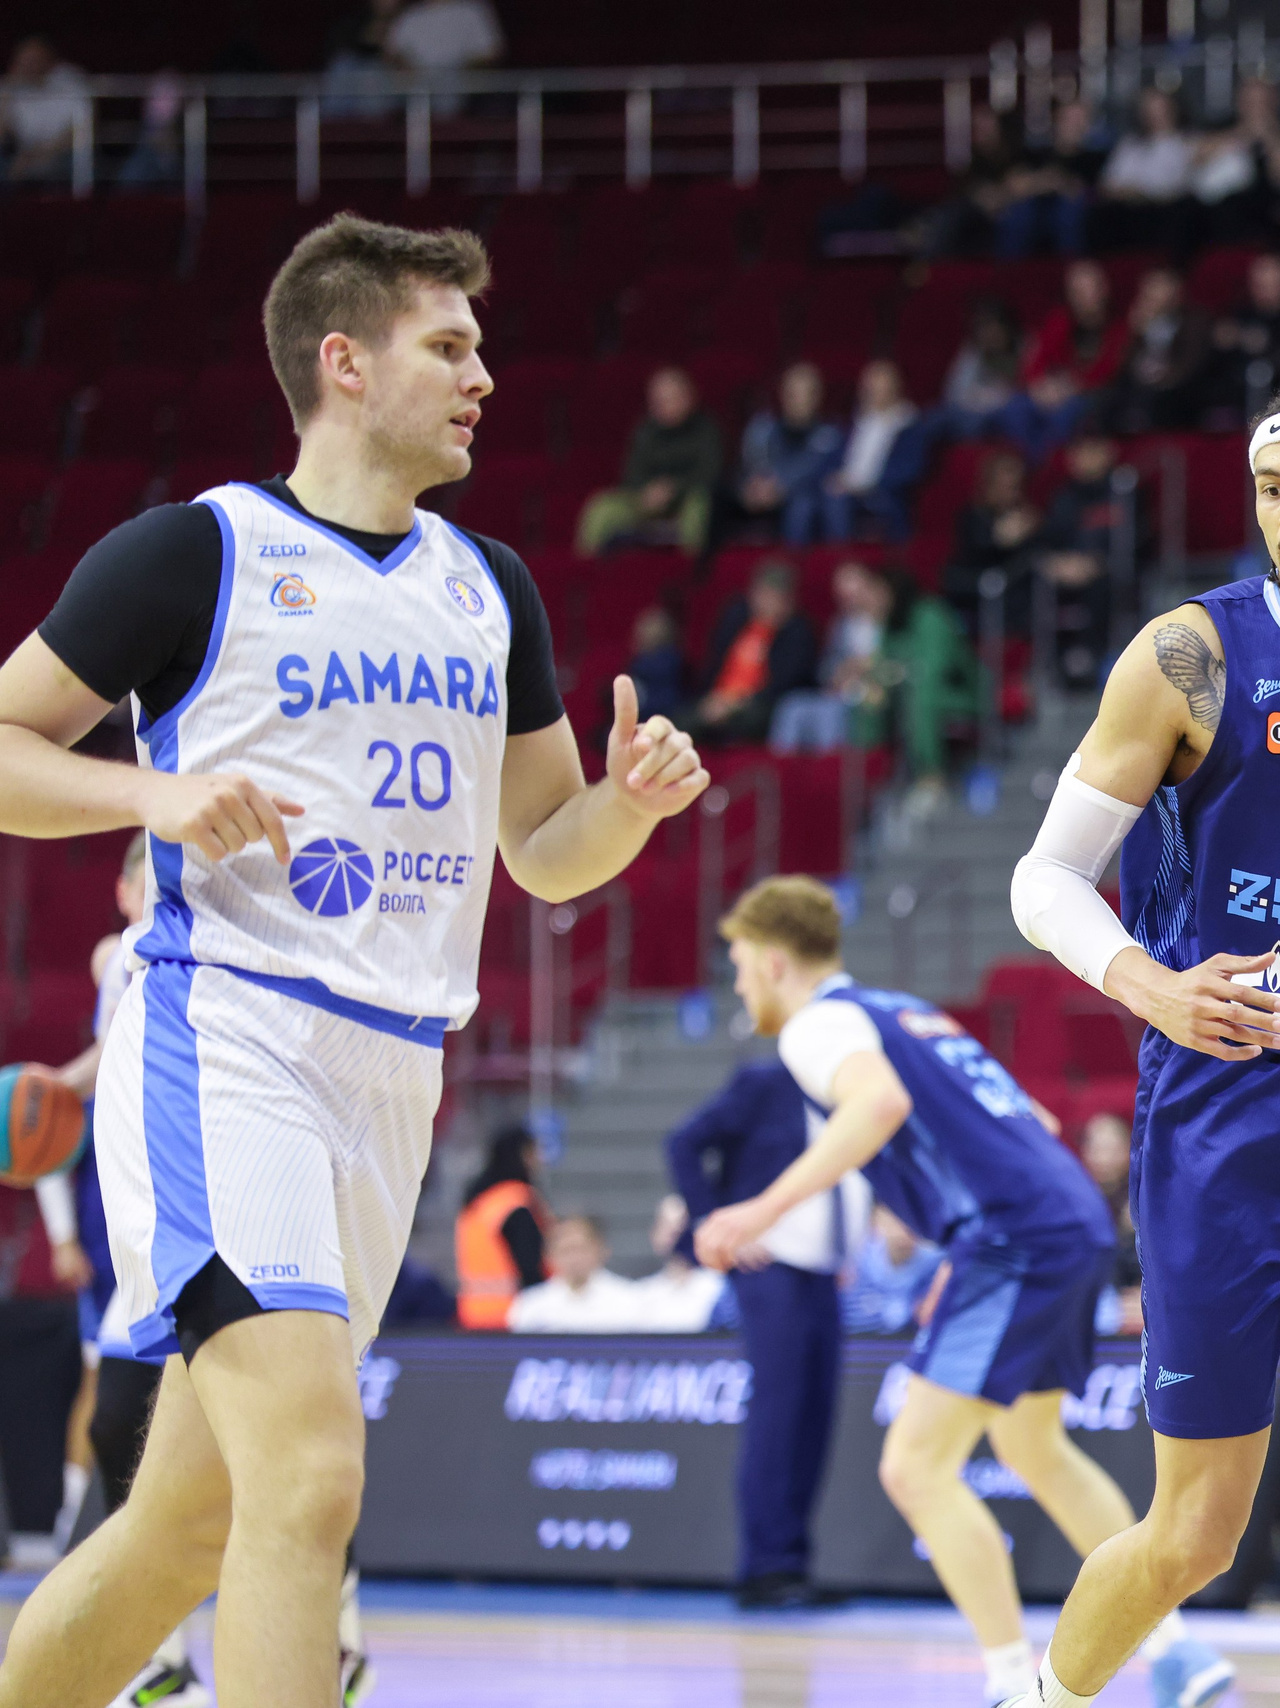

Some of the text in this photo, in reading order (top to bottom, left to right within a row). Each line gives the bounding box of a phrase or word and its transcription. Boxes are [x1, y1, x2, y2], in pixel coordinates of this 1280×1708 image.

[257, 544, 307, 557] ZEDO
[276, 651, 498, 718] SAMARA
[367, 740, 451, 811] 20
[379, 893, 426, 915] ВОЛГА
[248, 1264, 300, 1278] ZEDO
